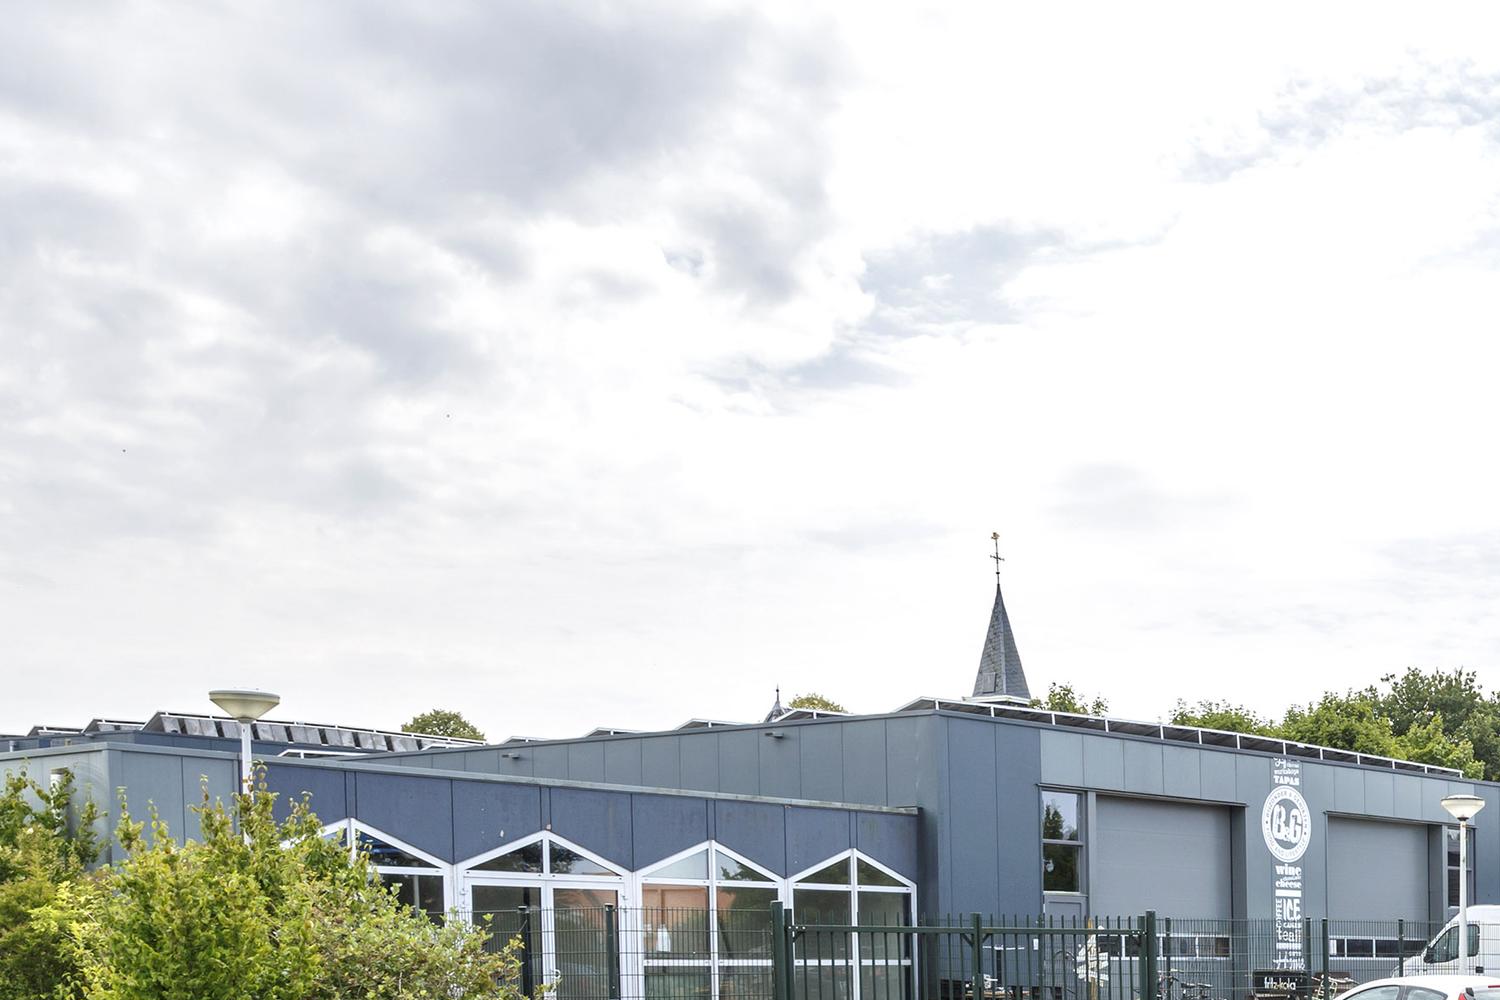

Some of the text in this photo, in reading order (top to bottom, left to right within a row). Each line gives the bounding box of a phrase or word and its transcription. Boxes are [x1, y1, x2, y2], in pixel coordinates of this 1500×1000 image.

[1273, 775, 1299, 786] TAPAS
[1275, 863, 1302, 876] wine
[1275, 878, 1302, 889] cheese
[1283, 898, 1302, 921] ICE
